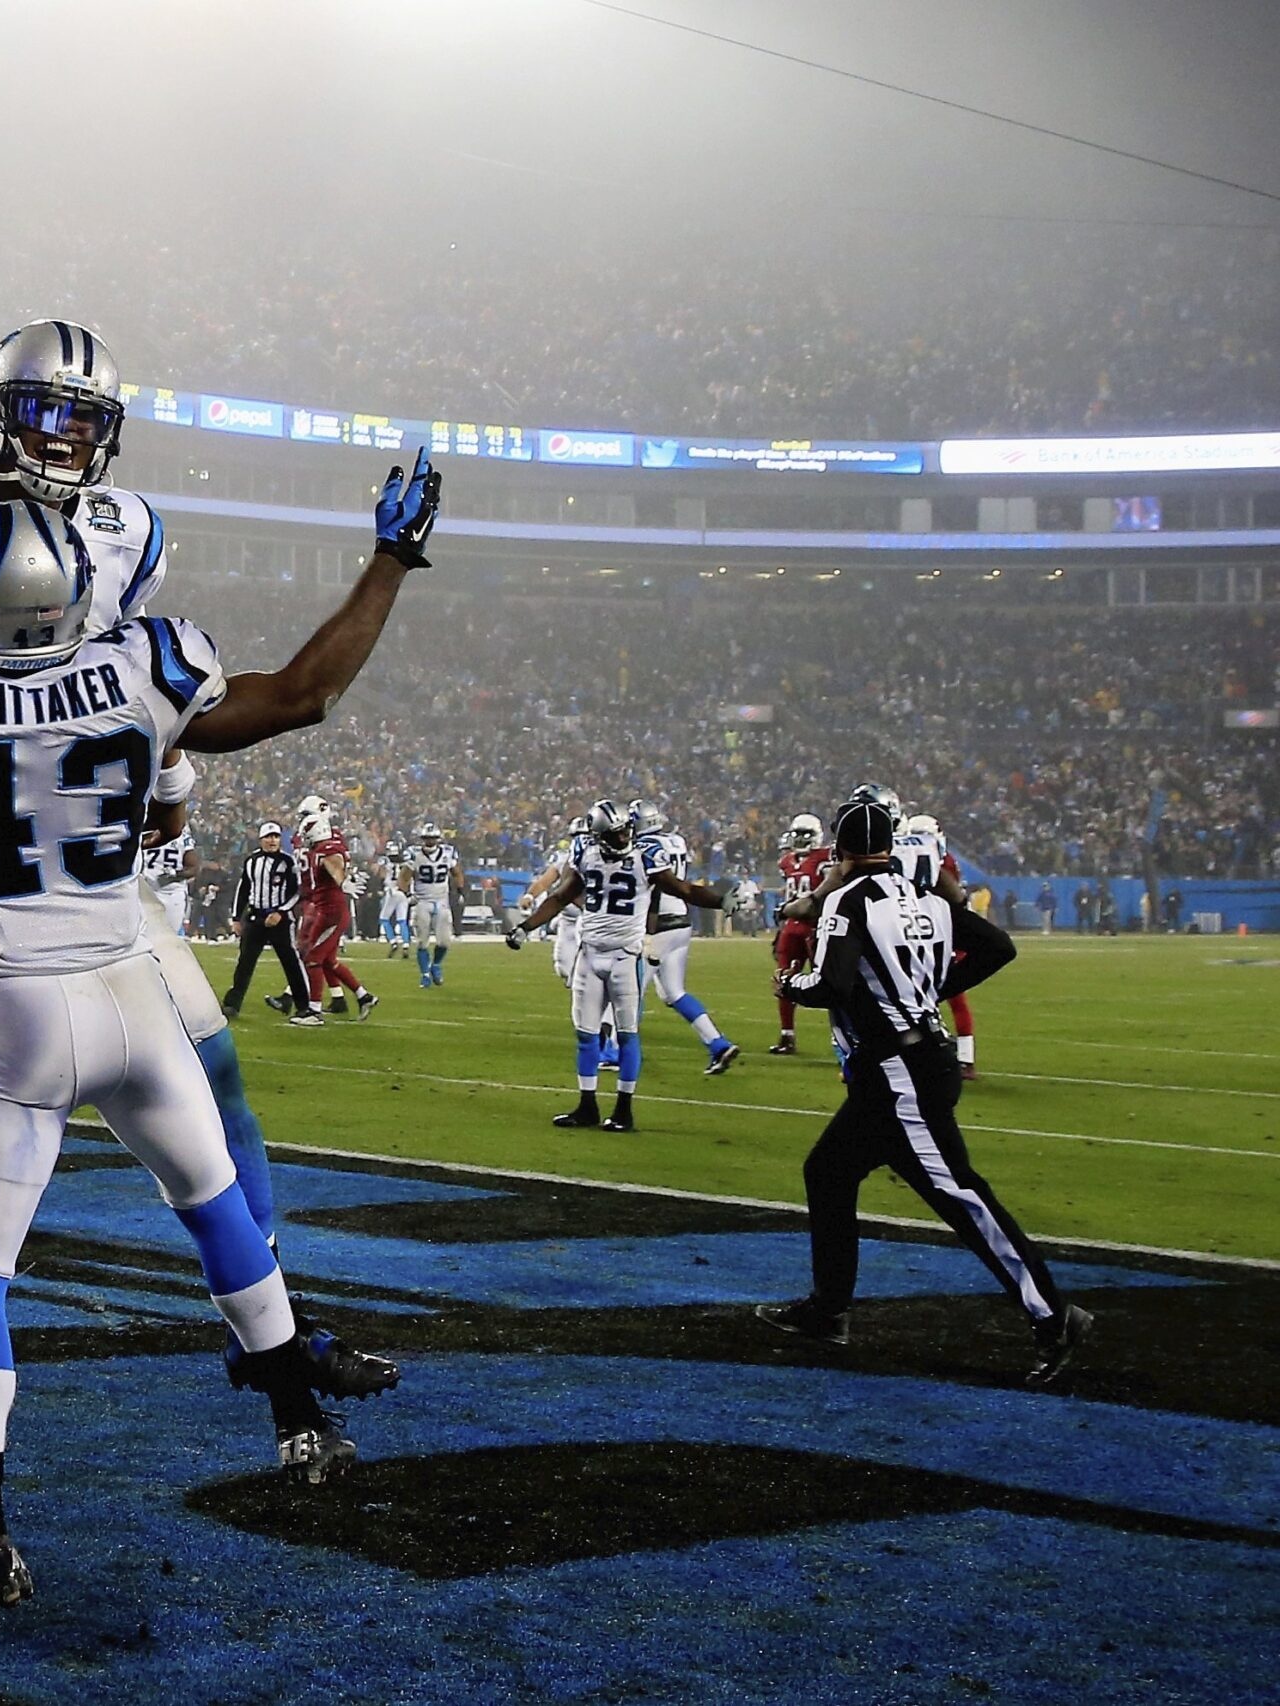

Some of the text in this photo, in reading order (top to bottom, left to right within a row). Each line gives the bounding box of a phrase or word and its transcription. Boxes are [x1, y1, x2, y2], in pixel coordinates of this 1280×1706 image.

[229, 409, 274, 428] pepsi
[572, 440, 622, 459] pepsi
[13, 625, 55, 648] 43
[146, 849, 180, 870] 75
[420, 864, 450, 884] 92
